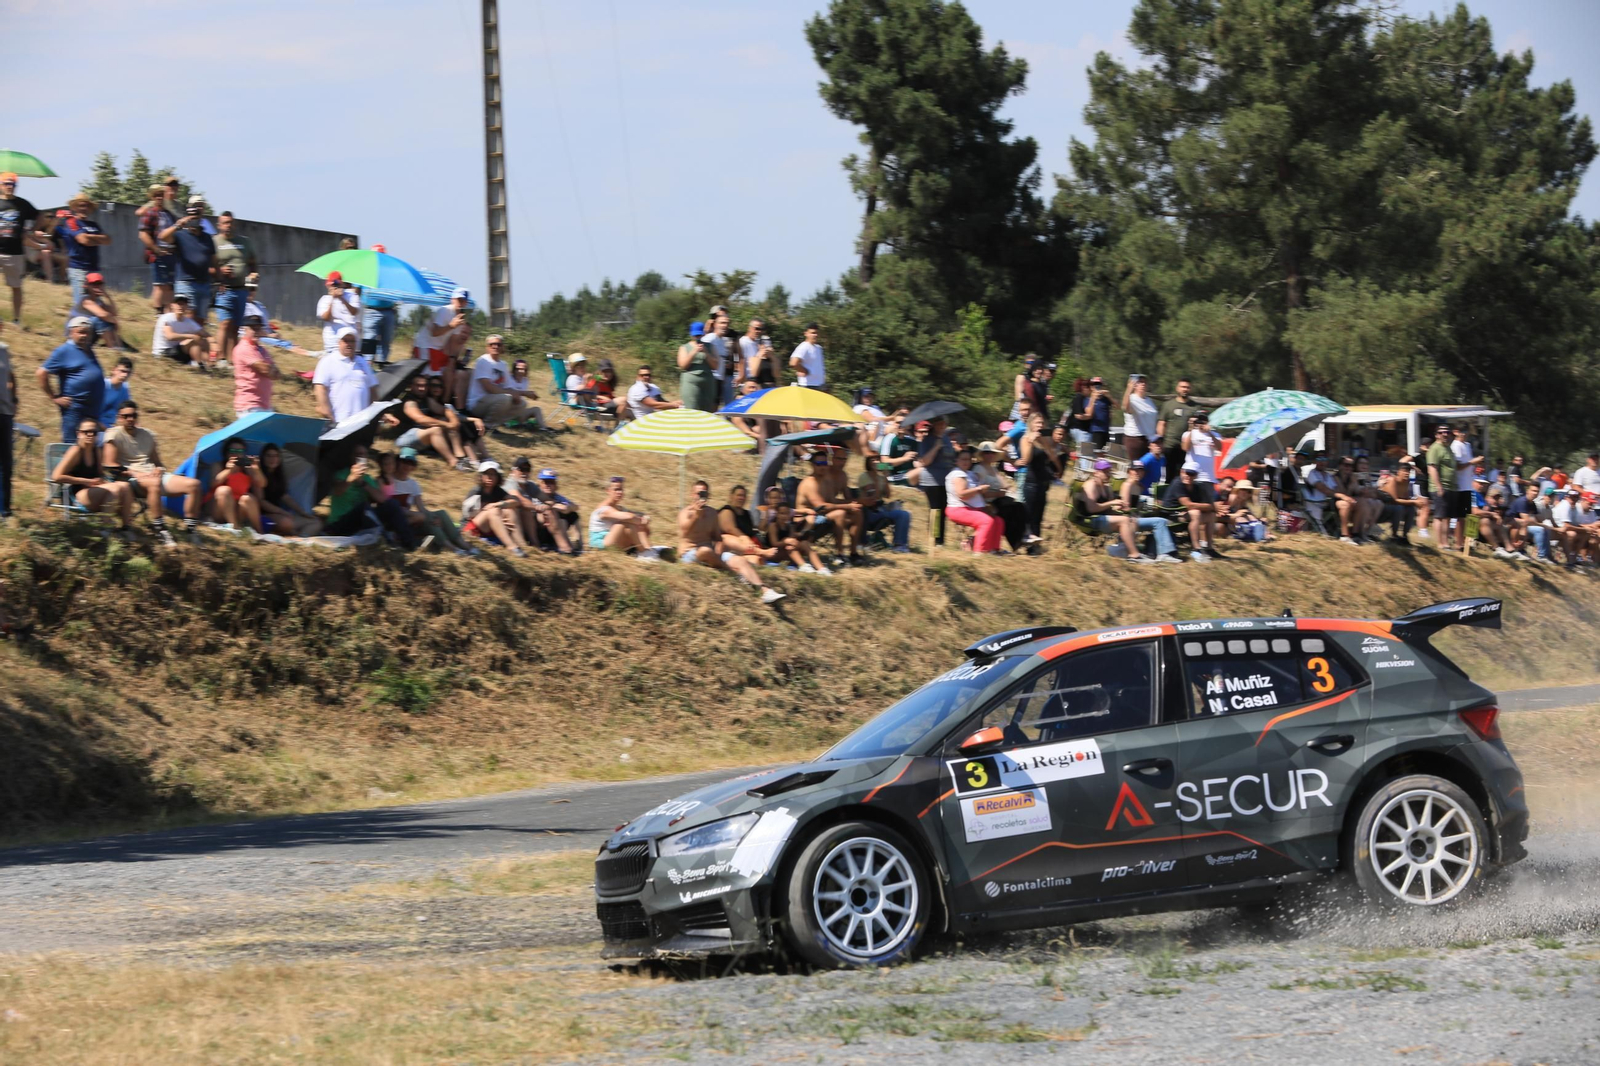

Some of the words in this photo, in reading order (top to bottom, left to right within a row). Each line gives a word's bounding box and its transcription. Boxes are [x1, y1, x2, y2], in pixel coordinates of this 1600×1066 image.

[1000, 633, 1033, 647] MICHELIN
[1361, 645, 1390, 654] SUOMI
[1375, 660, 1415, 669] HIKVISION
[1307, 657, 1335, 693] 3
[1226, 674, 1273, 693] Muñiz
[1208, 698, 1229, 713] N.
[1231, 691, 1278, 710] Casal
[1001, 760, 1028, 774] La
[965, 762, 989, 788] 3
[986, 796, 1023, 811] Recalvi
[991, 818, 1027, 830] recoletas
[1028, 815, 1049, 825] salud
[692, 885, 732, 899] MICHELIN
